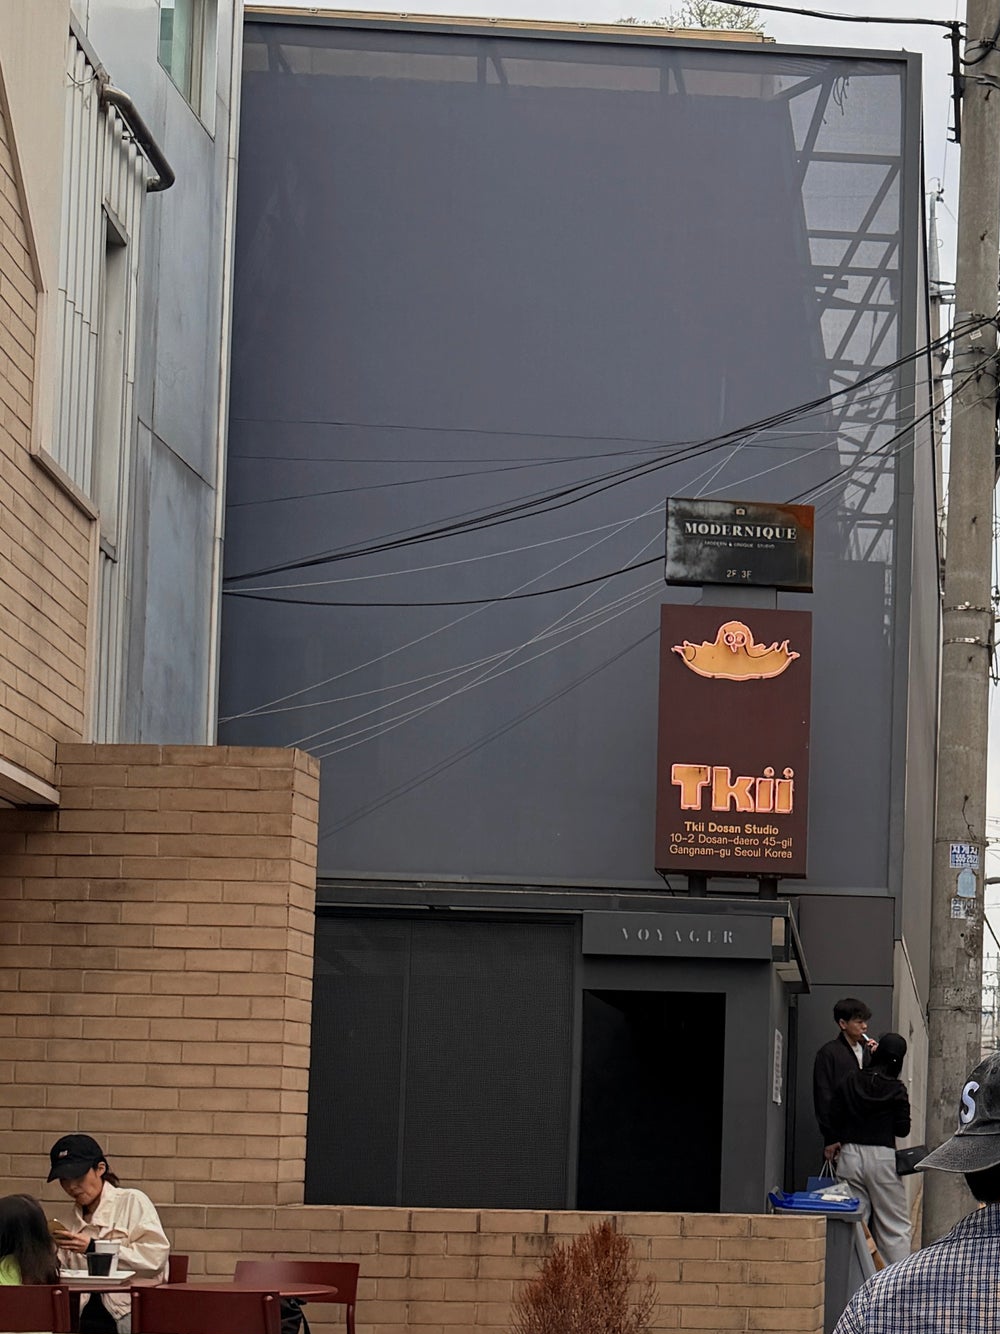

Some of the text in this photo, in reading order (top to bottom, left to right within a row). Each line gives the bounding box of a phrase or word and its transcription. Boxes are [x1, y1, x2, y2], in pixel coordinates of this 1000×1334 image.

[685, 522, 797, 540] MODERNIQUE
[726, 569, 752, 579] 2F 3F
[671, 764, 794, 814] Tkii
[684, 821, 779, 835] Tkii Dosan Studio
[670, 833, 793, 849] 10-2 Dosan-daero 45-gil
[669, 844, 793, 859] Gangnam-gu Seoul Korea
[622, 927, 733, 944] VOYAGER
[960, 1080, 980, 1124] S
